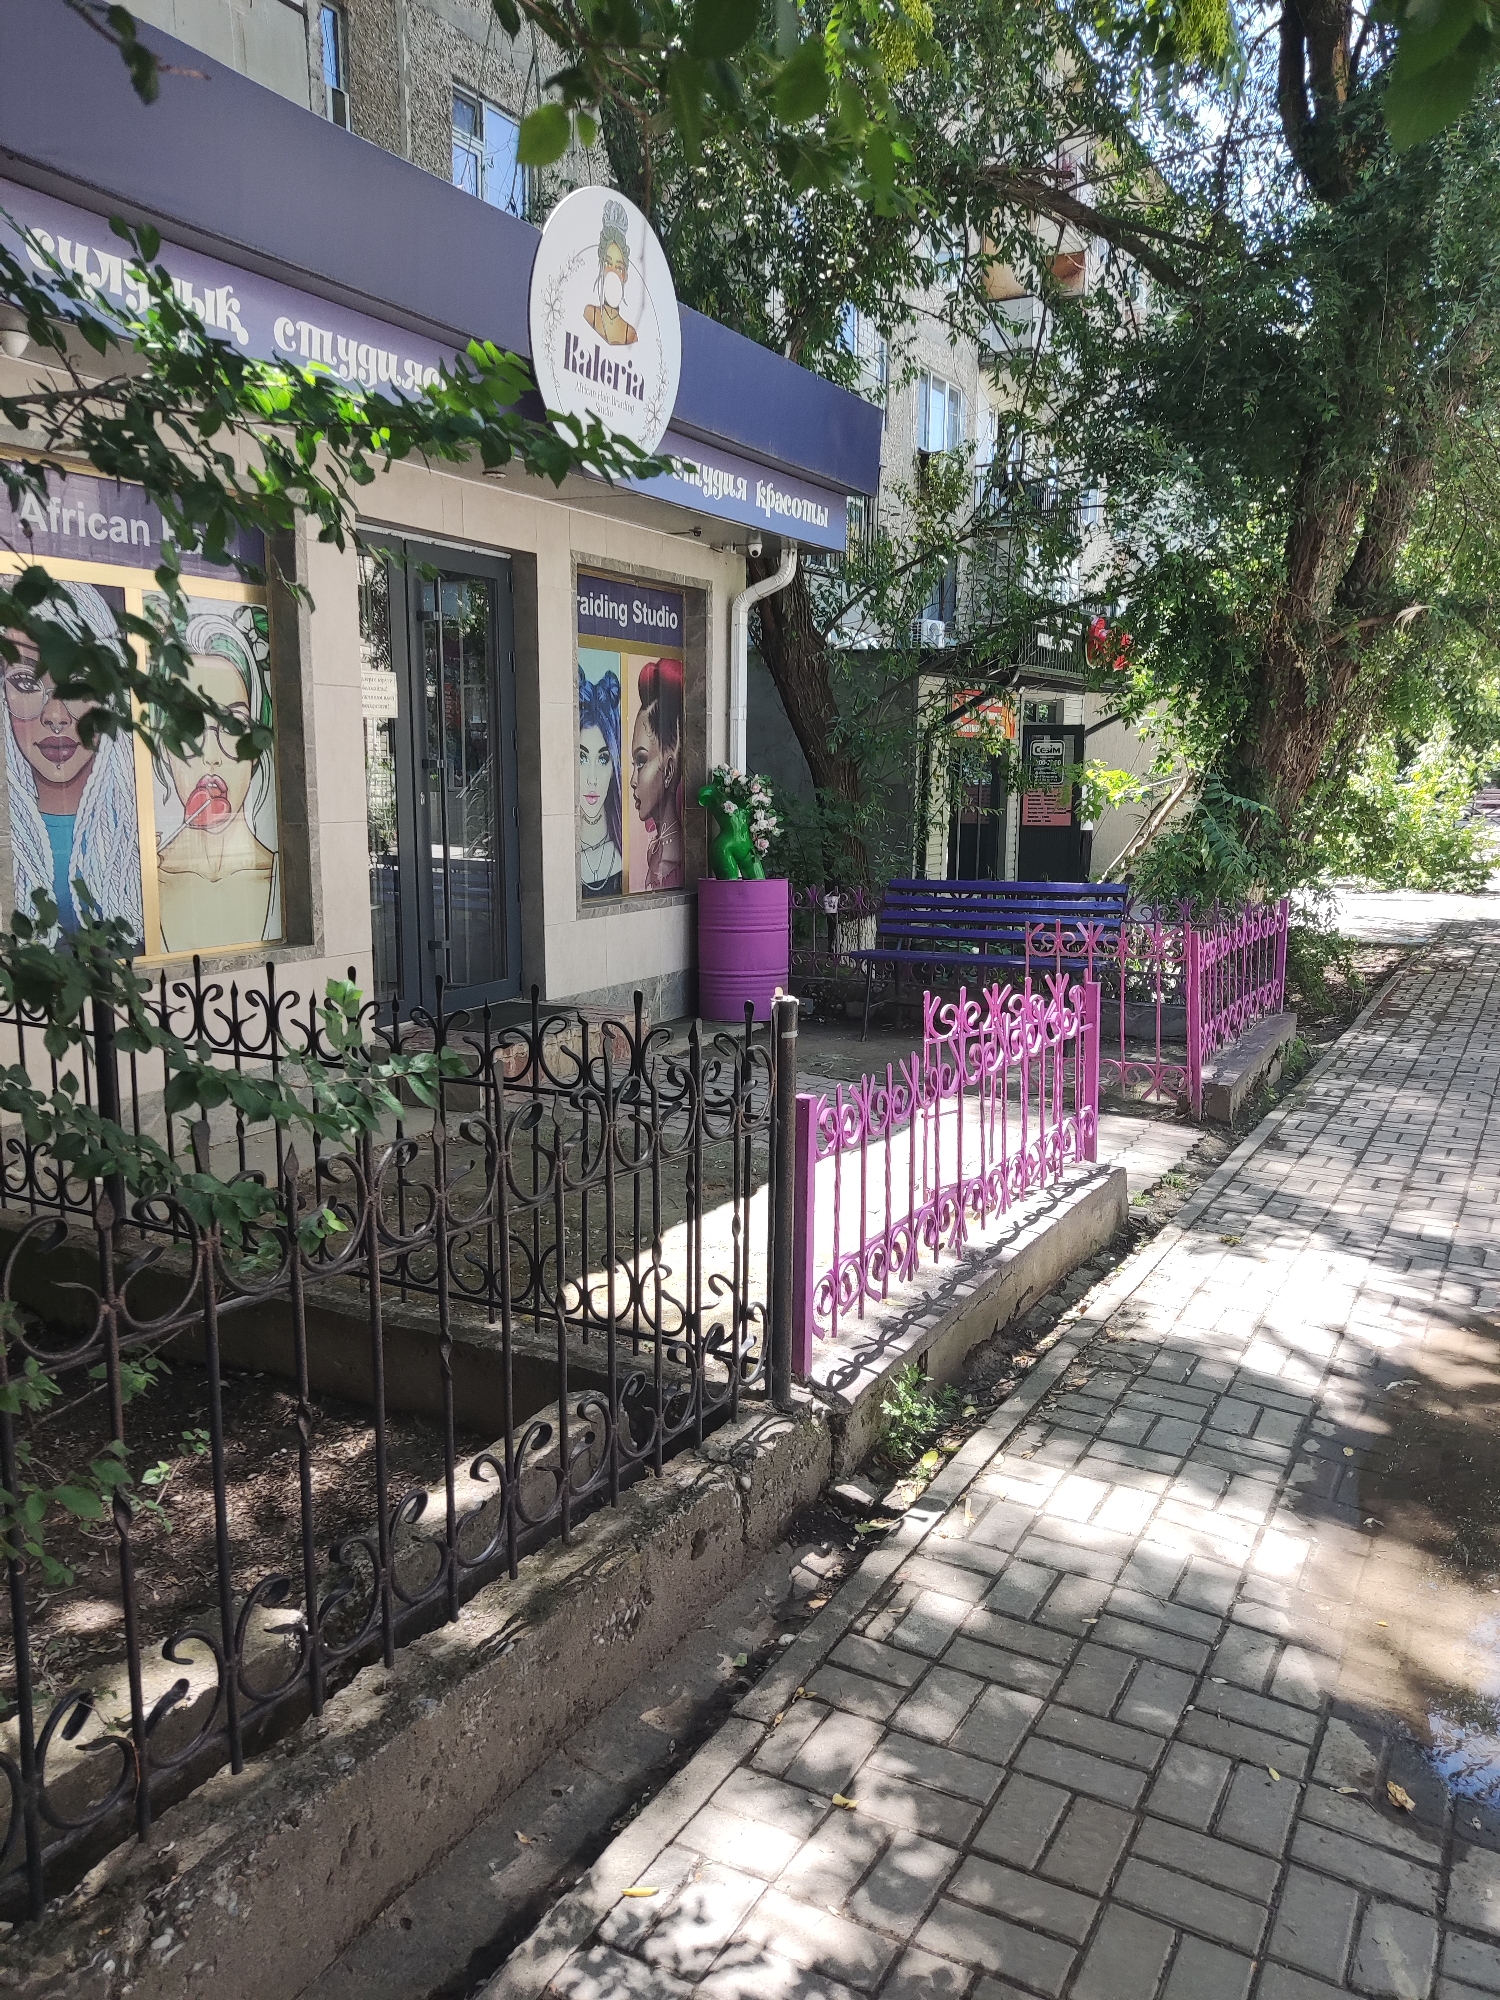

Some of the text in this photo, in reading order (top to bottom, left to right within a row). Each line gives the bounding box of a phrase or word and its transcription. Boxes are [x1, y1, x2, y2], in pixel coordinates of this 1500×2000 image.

[563, 330, 645, 402] Kaleria
[18, 492, 151, 547] African
[755, 479, 830, 529] красоты
[632, 599, 678, 630] Studio
